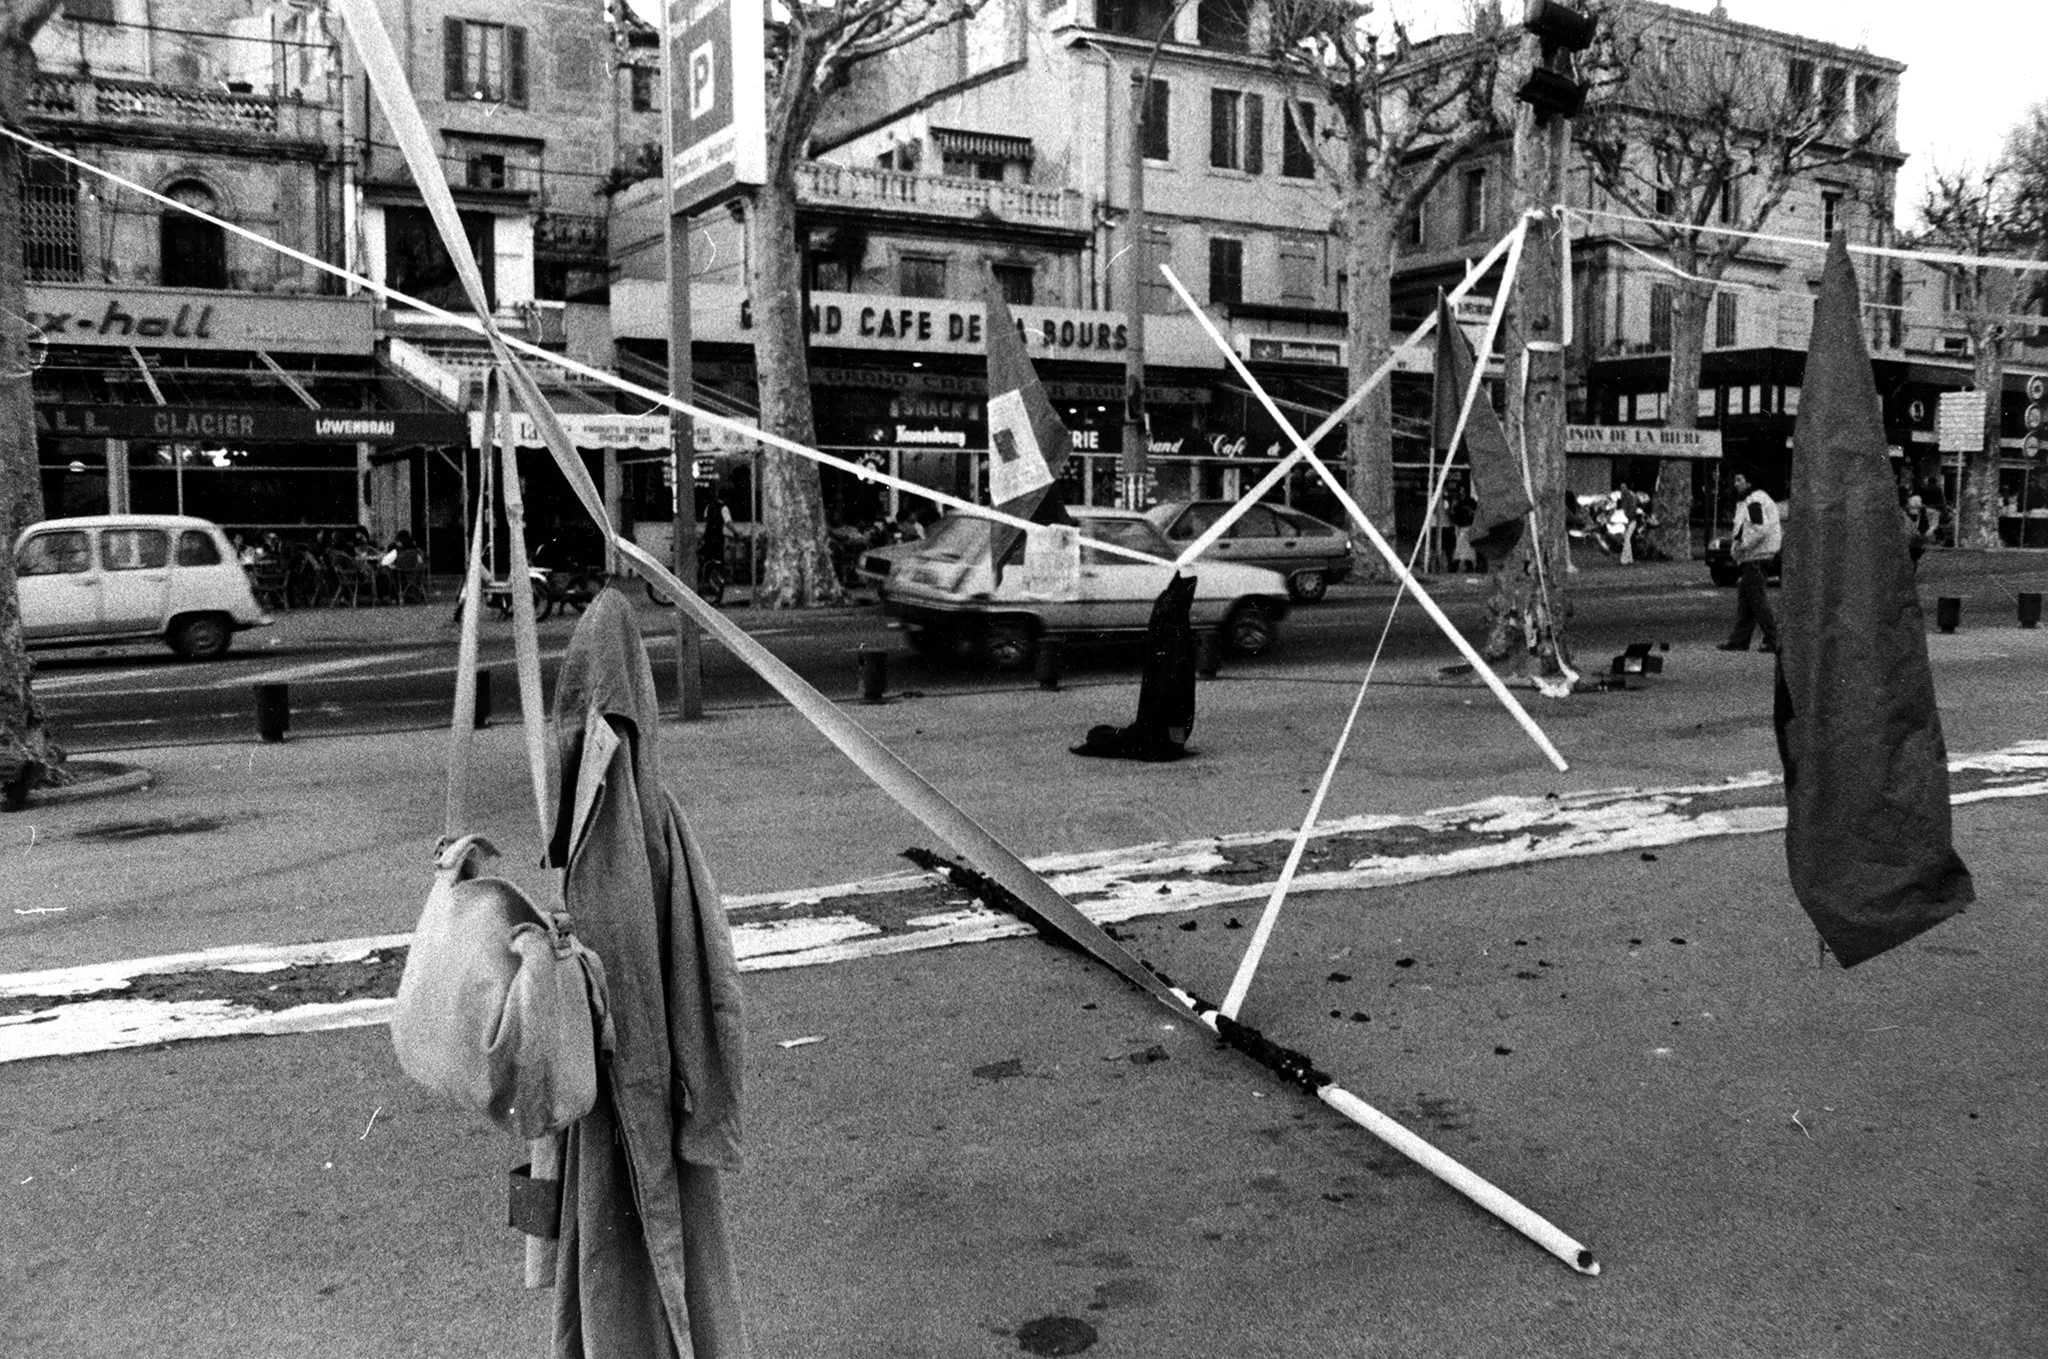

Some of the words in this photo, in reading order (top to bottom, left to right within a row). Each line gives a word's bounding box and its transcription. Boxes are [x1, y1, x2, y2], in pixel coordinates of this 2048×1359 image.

[860, 307, 931, 340] CAFE
[949, 313, 981, 342] DE
[1042, 319, 1128, 350] BOURS
[153, 412, 253, 436] GLACIER
[1569, 427, 1604, 440] ISON
[1067, 429, 1099, 449] RIE
